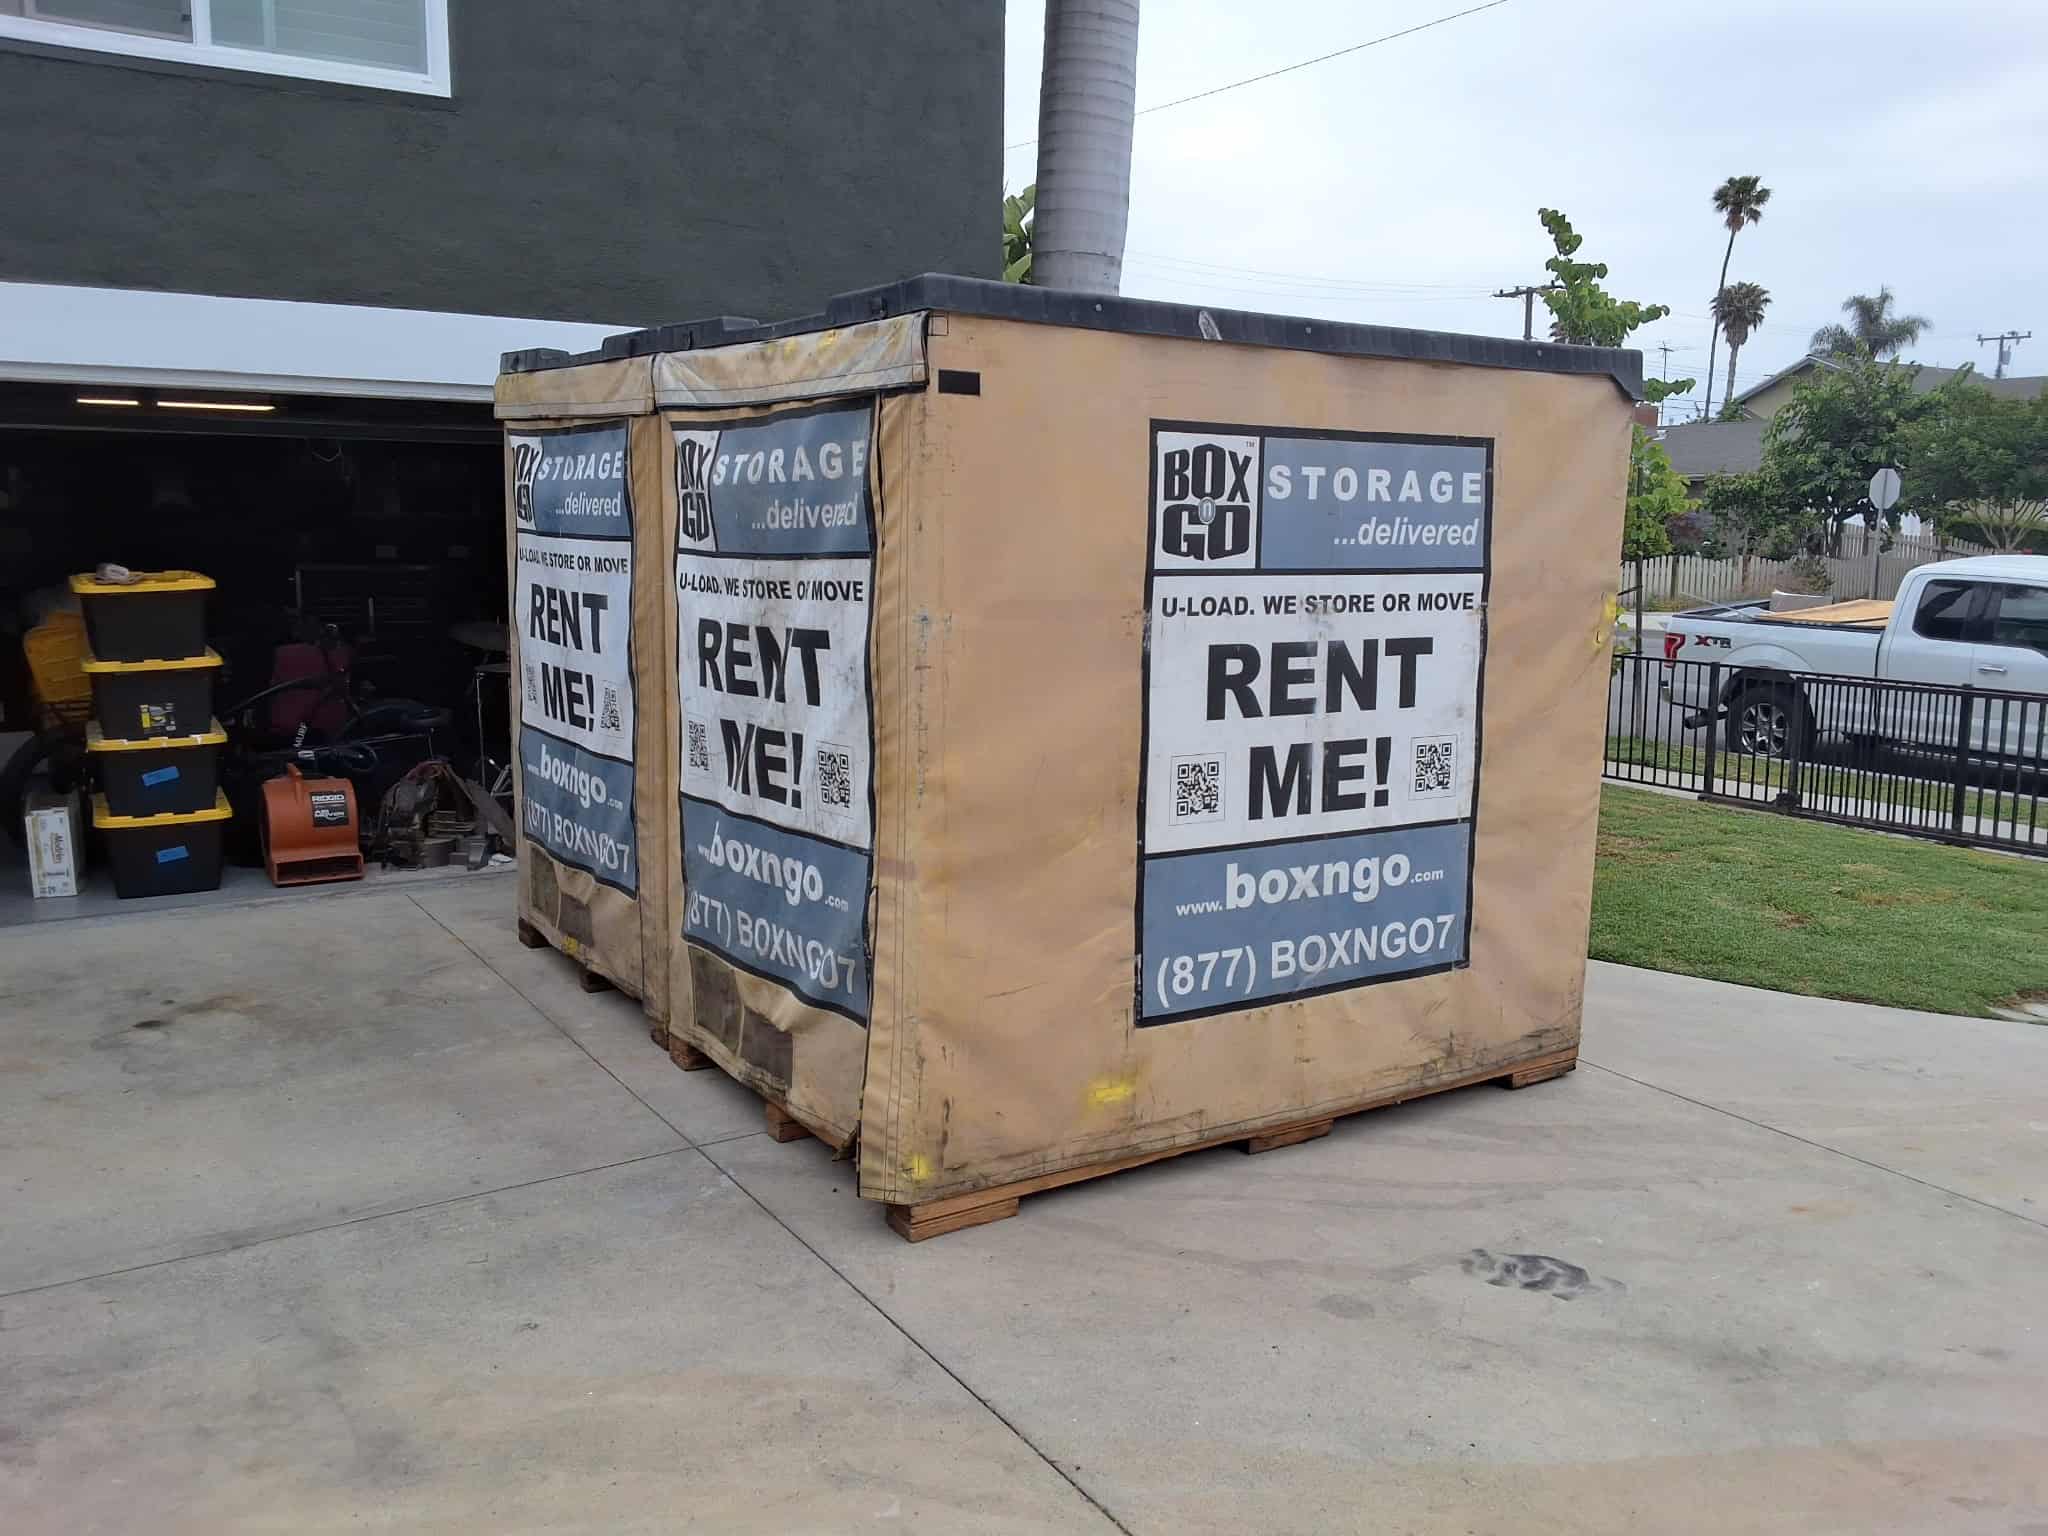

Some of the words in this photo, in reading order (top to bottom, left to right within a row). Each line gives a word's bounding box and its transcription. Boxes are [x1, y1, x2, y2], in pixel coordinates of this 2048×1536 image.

[537, 451, 623, 481] STORAGE
[712, 440, 865, 486] STORAGE
[1164, 443, 1252, 503] BOX
[1267, 465, 1482, 504] STORAGE
[751, 493, 858, 529] ...delivered
[1162, 503, 1250, 561] GO
[1333, 516, 1480, 546] ...delivered
[549, 553, 575, 570] STORE
[577, 555, 591, 572] OR
[595, 556, 628, 574] MOVE
[679, 572, 722, 594] U-LOAD.
[724, 577, 740, 597] WE
[742, 580, 792, 600] STORE
[811, 580, 864, 601] MOVE
[530, 583, 608, 654] RENT
[1161, 595, 1255, 618] U-LOAD.
[1263, 595, 1297, 615] WE
[1304, 594, 1375, 615] STORE
[1382, 593, 1411, 612] OR
[1417, 592, 1474, 611] MOVE
[699, 616, 831, 707] RENT
[1206, 636, 1434, 721] RENT
[541, 661, 595, 732] ME!
[719, 718, 804, 809] ME!
[1248, 736, 1392, 821] ME!
[1176, 853, 1444, 917] www.boxngo.com
[687, 890, 731, 947] (877)
[737, 909, 856, 994] BOXNGO7
[1156, 944, 1257, 1008] (877)
[1271, 913, 1455, 980] BOXNGO7
